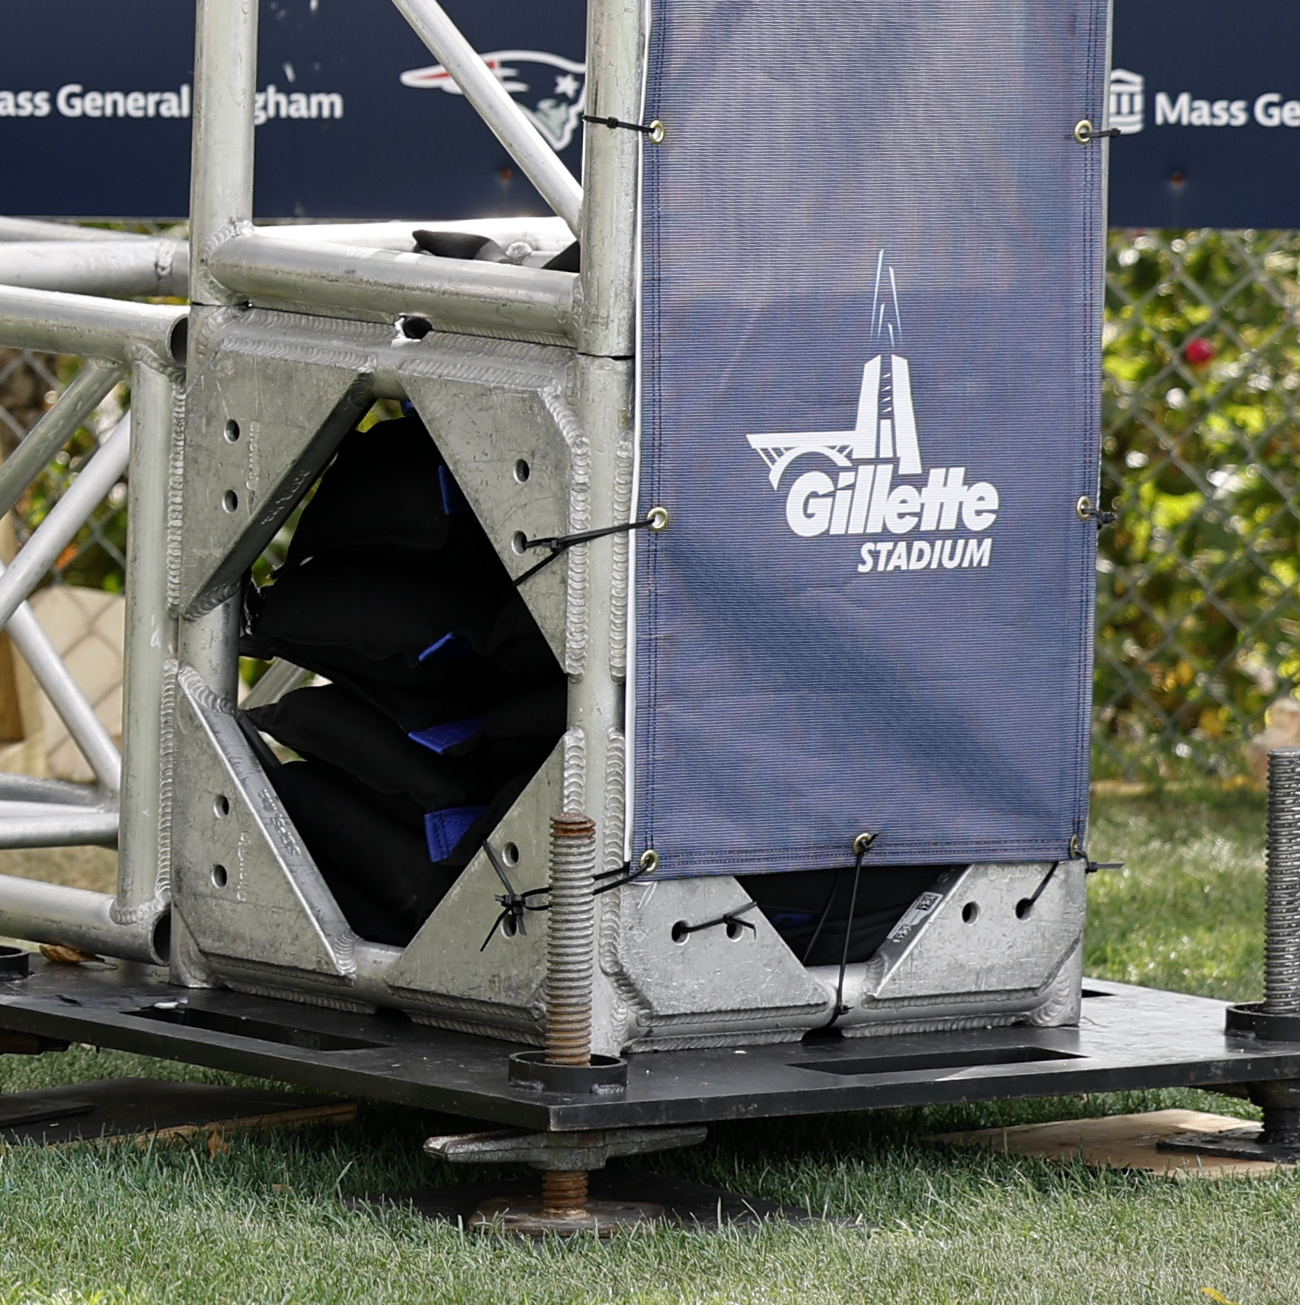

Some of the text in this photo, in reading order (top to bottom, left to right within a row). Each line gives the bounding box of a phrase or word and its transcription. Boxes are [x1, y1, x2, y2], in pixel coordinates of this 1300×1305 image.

[56, 83, 190, 118] General
[254, 84, 344, 125] gham
[1154, 92, 1248, 126] Mass
[786, 463, 999, 537] Gillette
[857, 538, 992, 573] STADIUM
